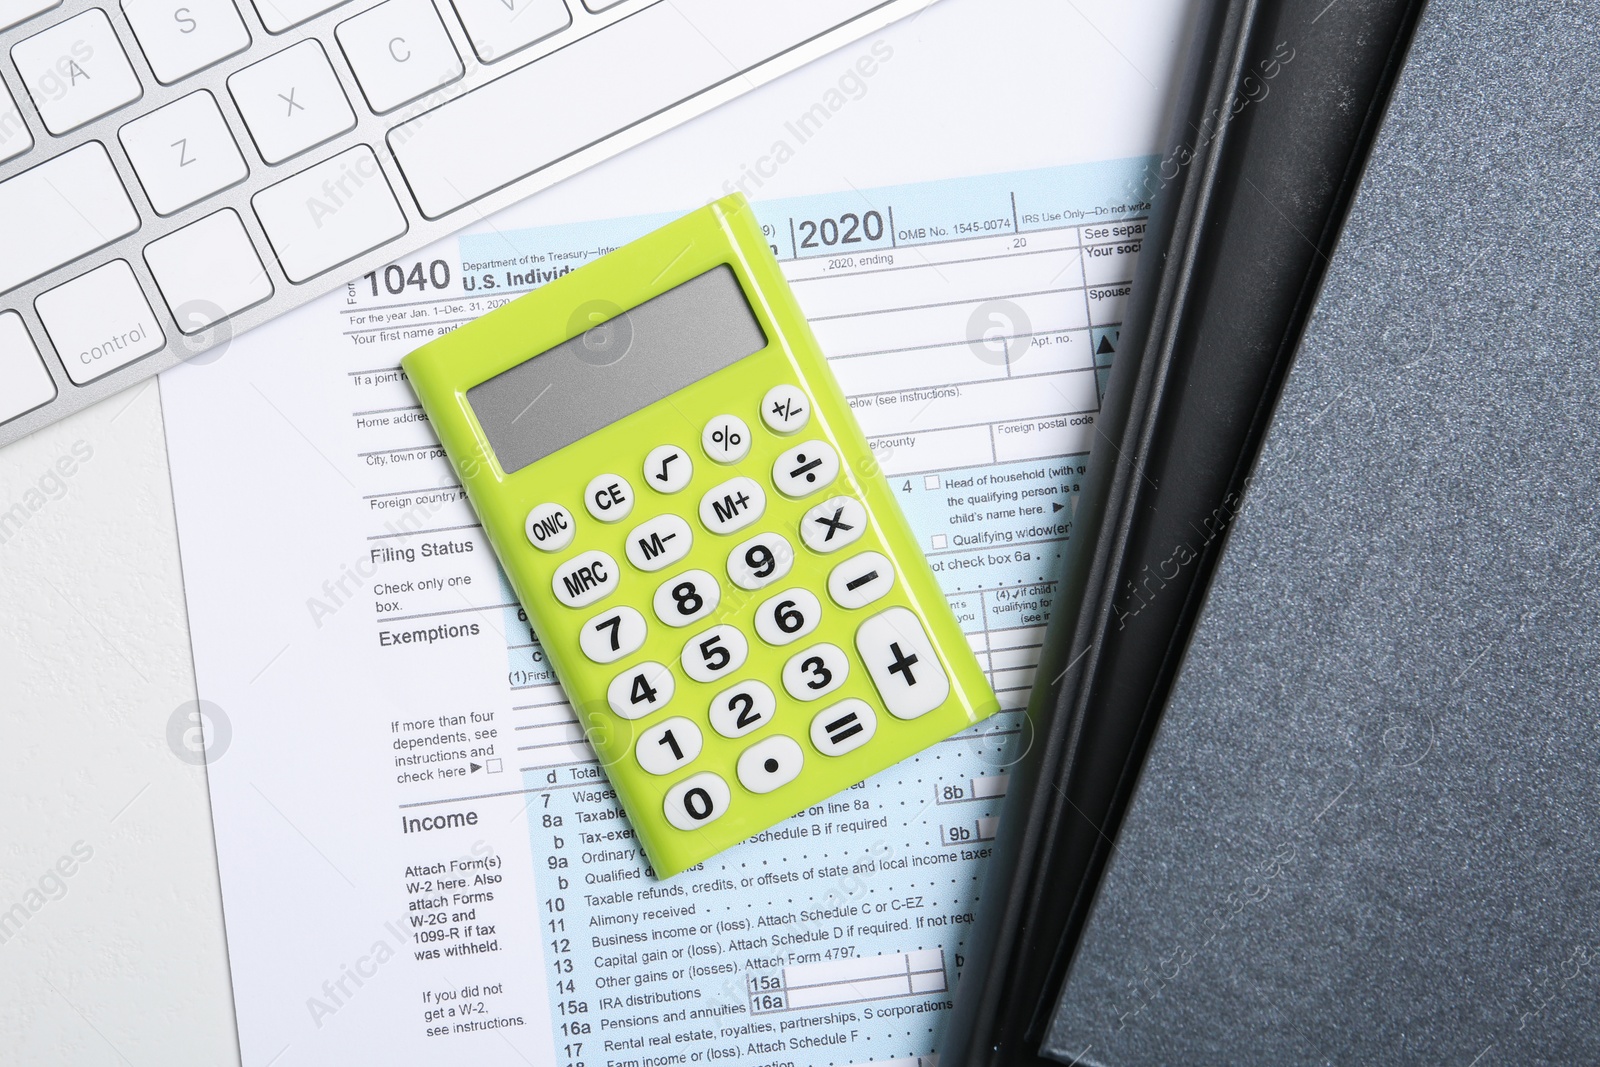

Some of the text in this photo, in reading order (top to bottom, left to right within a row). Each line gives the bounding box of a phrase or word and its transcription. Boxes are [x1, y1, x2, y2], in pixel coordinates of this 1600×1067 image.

[174, 8, 197, 35] S
[388, 37, 411, 63] C
[69, 58, 91, 88] A
[276, 86, 305, 118] X
[170, 138, 197, 168] Z
[799, 209, 884, 250] 2020
[898, 218, 1011, 241] OMB No. 1545-0074
[364, 258, 450, 298] 1040
[462, 273, 501, 292] U.S.
[79, 323, 147, 366] control
[1031, 335, 1073, 348] Apt. no.
[997, 415, 1094, 434] Foreign postal code
[902, 465, 1074, 493] 4 Head of household (with
[370, 492, 456, 510] Foreign country
[594, 483, 626, 512] CE
[713, 492, 749, 522] M+
[946, 484, 1080, 507] the qualifying person is a
[532, 511, 568, 542] ON/C
[949, 506, 1046, 525] child's name here.
[370, 540, 474, 564] Filing Status
[952, 531, 1013, 546] Qualifying
[745, 545, 775, 577] 9
[947, 550, 1031, 570] check box 6a
[373, 575, 472, 596] Check only one
[562, 559, 609, 598] MRC
[375, 601, 403, 613] box.
[672, 582, 703, 615] 8
[775, 601, 804, 633] 6
[378, 623, 480, 647] Exemptions
[596, 616, 621, 651] 7
[700, 636, 730, 670] 5
[801, 657, 832, 689] 3
[631, 674, 656, 704] 4
[390, 711, 494, 733] If more than four
[729, 694, 761, 729] 2
[392, 728, 498, 751] dependents, see
[659, 730, 683, 760] 1
[394, 743, 495, 767] instructions and
[396, 767, 466, 784] check here
[540, 793, 551, 809] 7
[684, 788, 713, 820] 0
[401, 811, 478, 834] Income
[541, 813, 563, 829] 8a
[404, 854, 502, 878] Attach Form(s)
[547, 855, 569, 870] 9a
[405, 873, 503, 894] W-2 here. Also
[545, 852, 958, 913] 10 Taxable refunds, credits, or offsets of state and local income
[408, 891, 494, 912] attach Forms
[409, 907, 476, 928] W-2G and
[548, 902, 696, 933] 11 Alimony received
[550, 895, 924, 954] 12 Business income or (loss). Attach Schedule C or C-EZ
[412, 924, 496, 944] 1099-R if tax
[553, 914, 948, 974] 13 Capital gain or (loss). Attach Schedule D if required. If not
[413, 938, 502, 961] was withheld.
[555, 978, 576, 995] 14
[594, 975, 631, 989] Other
[633, 970, 668, 987] gains
[671, 968, 685, 979] or
[688, 961, 741, 980] (losses).
[744, 955, 784, 970] Attach
[787, 952, 822, 965] Form
[557, 975, 780, 1016] 15a IRA distributions 15a
[560, 995, 783, 1037] 16a Pensions and annuities 16a
[563, 1000, 953, 1059] 17 Rental real estate, royalties, partnerships, S corporations
